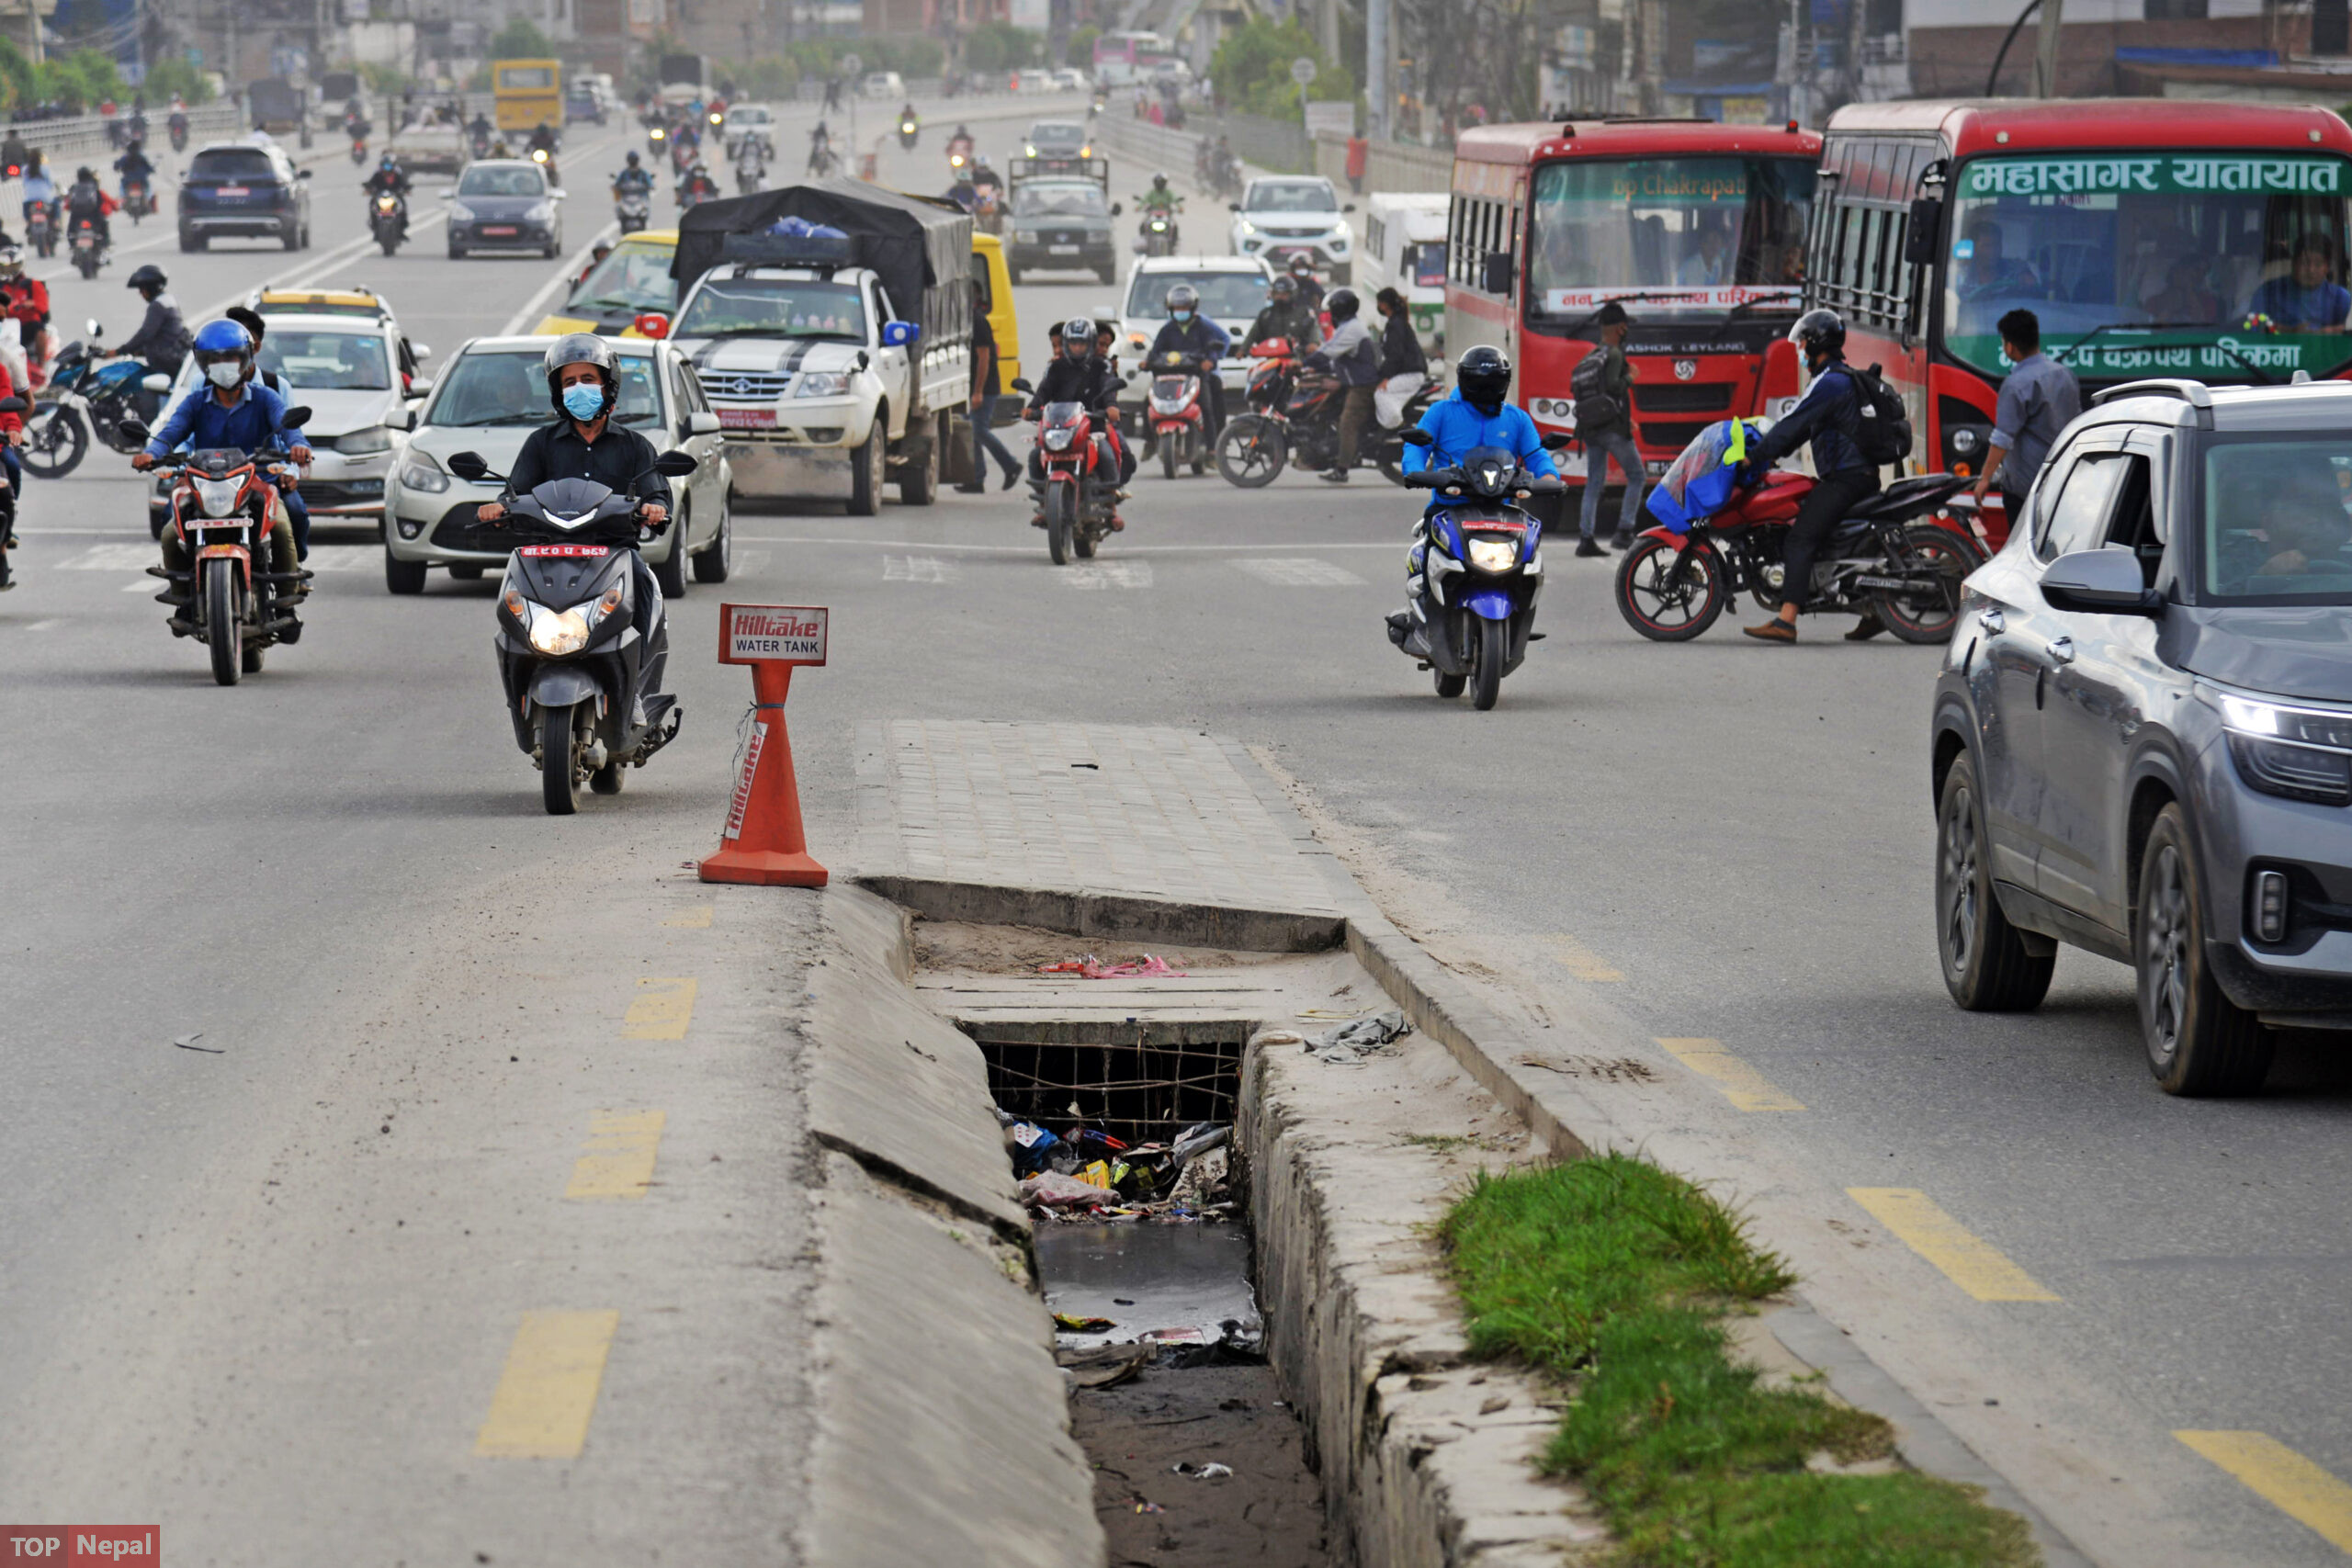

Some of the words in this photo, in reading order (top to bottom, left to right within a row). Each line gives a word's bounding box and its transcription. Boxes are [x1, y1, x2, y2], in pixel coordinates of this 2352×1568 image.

[1971, 159, 2161, 193] महासागर
[2172, 159, 2341, 191] यातायात
[1625, 344, 1672, 353] ASHOK
[1681, 342, 1746, 353] LEYLAND
[734, 615, 819, 637] Hilltake
[736, 639, 779, 652] WATER
[784, 640, 819, 653] TANK
[728, 734, 763, 830] Hilltake
